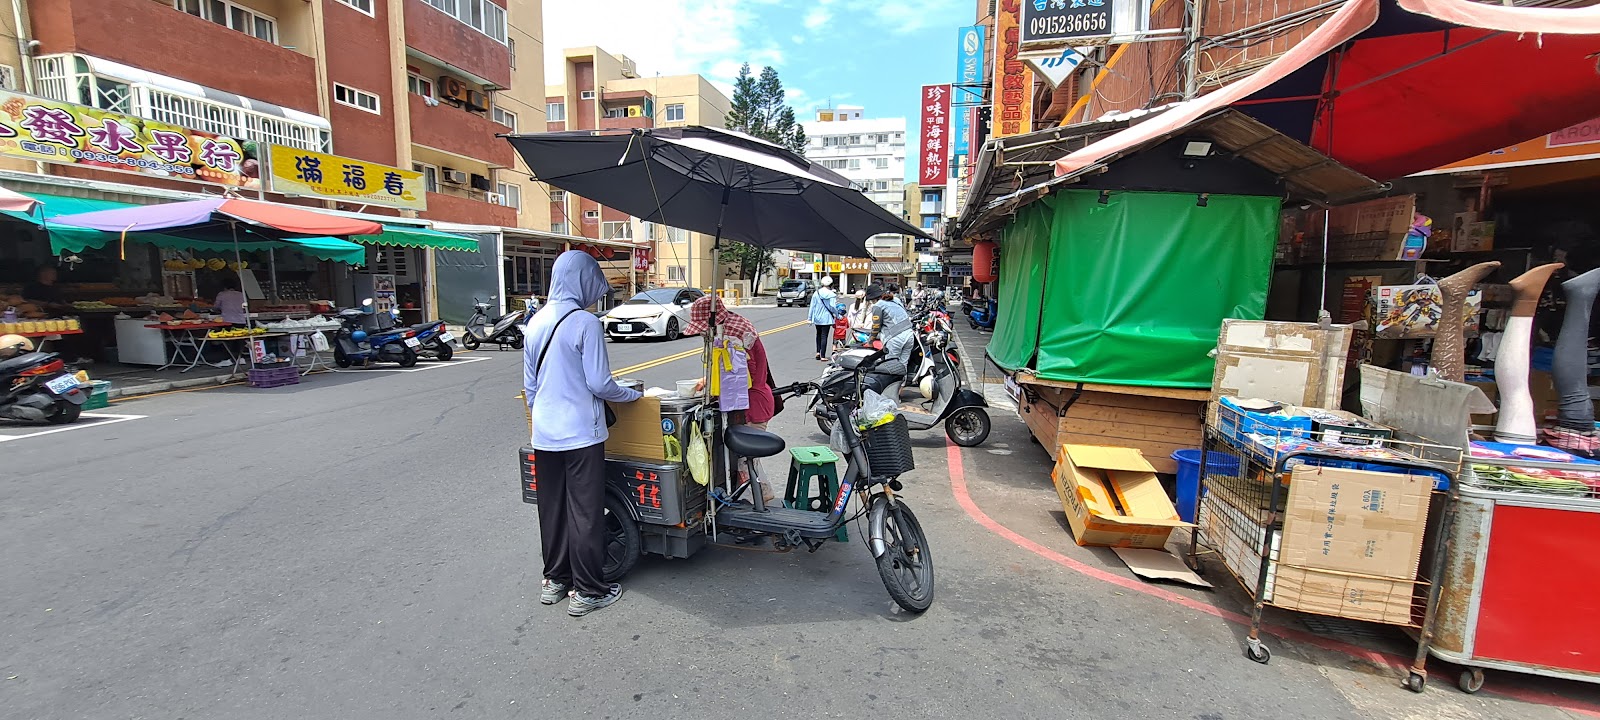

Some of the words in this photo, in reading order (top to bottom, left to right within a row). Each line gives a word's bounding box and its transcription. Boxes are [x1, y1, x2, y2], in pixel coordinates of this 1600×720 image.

[1030, 12, 1107, 35] 0915236656
[0, 105, 241, 172] 發水果行
[924, 125, 944, 181] 海鮮熱炒
[294, 155, 405, 196] 滿福春
